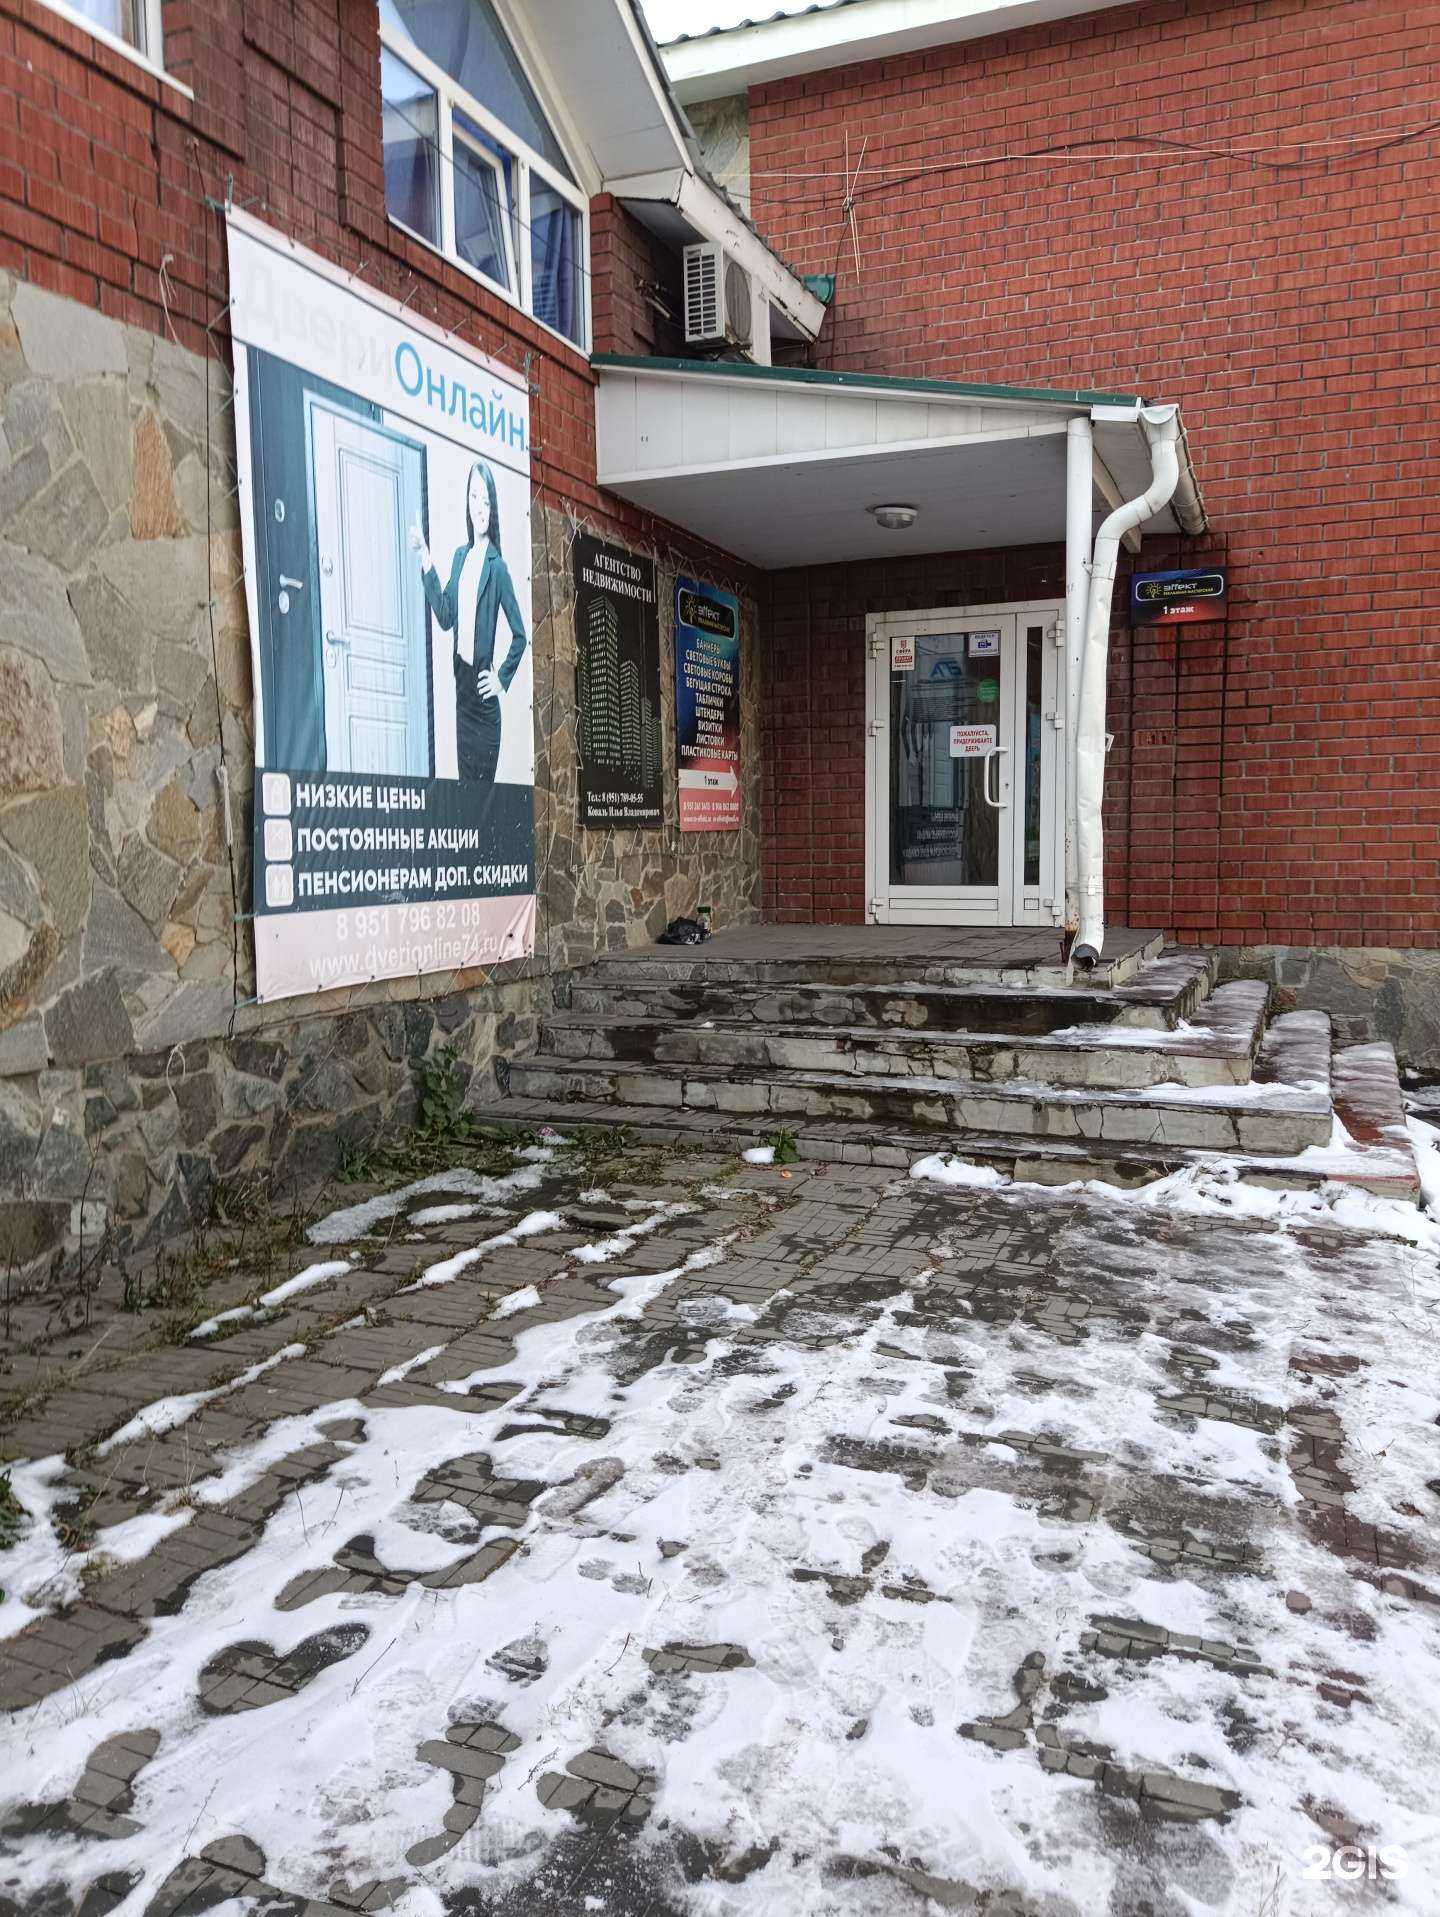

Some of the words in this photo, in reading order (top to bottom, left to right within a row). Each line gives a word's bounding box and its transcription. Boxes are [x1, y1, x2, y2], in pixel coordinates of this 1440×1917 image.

[593, 553, 641, 582] АГЕНТСТВО
[582, 567, 652, 603] НЕДВИЖИМОСТИ
[1163, 605, 1168, 615] 1
[1169, 606, 1195, 615] этаж
[696, 638, 720, 654] БАННЕРЫ
[685, 649, 713, 666] СВЕТОВЫЕ
[713, 656, 731, 671] БУКВЫ
[683, 662, 711, 680] СВЕТОВЫЕ
[686, 677, 711, 692] БЕГУЩАЯ
[711, 683, 732, 697] СТРОКА
[695, 692, 724, 708] ТАБЛИЧКИ
[695, 706, 725, 721] ШТЕНДЕРЫ
[698, 720, 723, 734] ВИЗИТКИ
[695, 733, 725, 746] ЛИСТОВКИ
[681, 744, 721, 760] ПЛАСТИКОВЫЕ
[721, 750, 738, 761] КАРТЫ
[296, 783, 373, 809] НИЗКИЕ
[376, 787, 426, 813] ЦЕНЫ
[297, 828, 424, 853] ПОСТОЯННЫЕ
[427, 828, 479, 853] АКЦИИ
[298, 867, 432, 897] ПЕНСИОНЕРАМ
[435, 868, 471, 893] ДОП.
[473, 864, 529, 888] СКИДКИ
[336, 913, 348, 940] 8
[354, 908, 390, 939] 951
[399, 906, 431, 934] 796
[436, 905, 456, 929] 82
[461, 903, 481, 927] 08
[309, 934, 498, 979] www.dverionline74.ru
